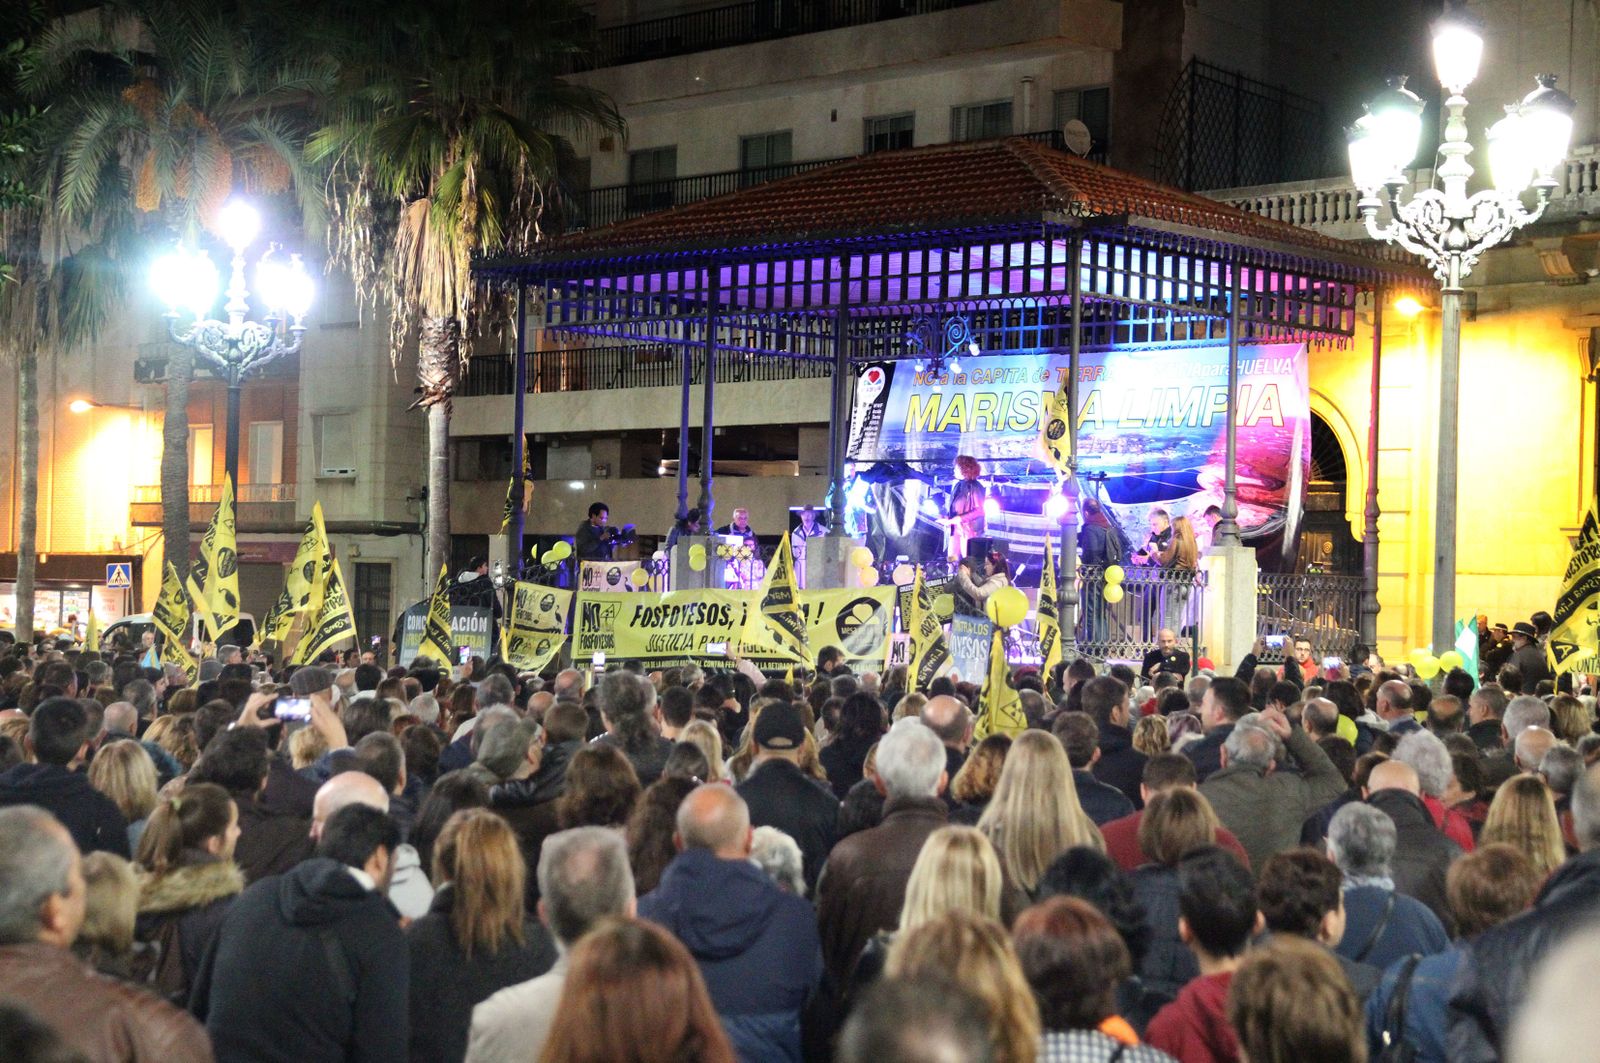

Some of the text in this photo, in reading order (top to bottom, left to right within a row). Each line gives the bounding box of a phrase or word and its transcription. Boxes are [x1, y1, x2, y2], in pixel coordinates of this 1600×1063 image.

[939, 373, 949, 385] a
[971, 367, 1028, 385] CAPITA
[1032, 366, 1050, 383] de
[1056, 366, 1113, 383] TERRA
[1117, 383, 1285, 429] LIMPIA
[582, 567, 593, 587] NO
[407, 611, 487, 633] CONCACIÓN
[581, 602, 601, 633] NO
[630, 602, 734, 630] FOSFOYESOS,
[973, 623, 989, 636] LOS
[580, 633, 615, 651] FOSFOYESOS
[645, 633, 694, 653] JUSTICIA
[891, 640, 906, 664] NO
[951, 633, 988, 662] OYESOS
